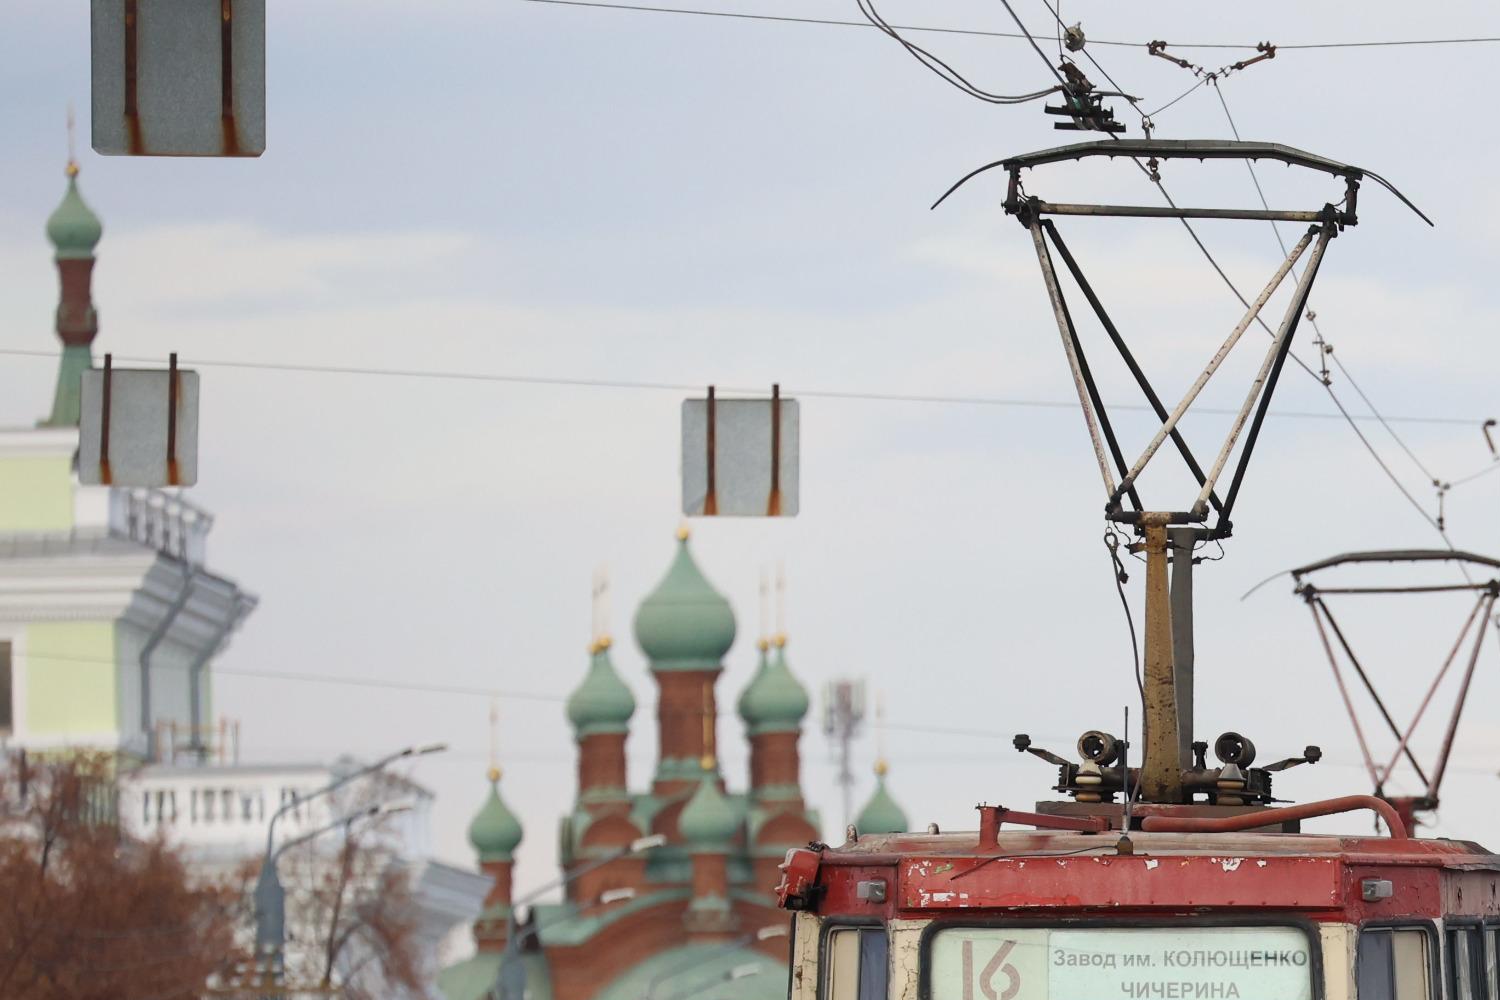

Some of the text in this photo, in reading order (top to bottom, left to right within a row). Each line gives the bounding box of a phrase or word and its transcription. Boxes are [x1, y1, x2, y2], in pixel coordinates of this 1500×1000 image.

[1053, 950, 1308, 969] Завод им. КОЛЮЩЕНКО
[1121, 982, 1240, 999] ЧИЧЕРИНА
